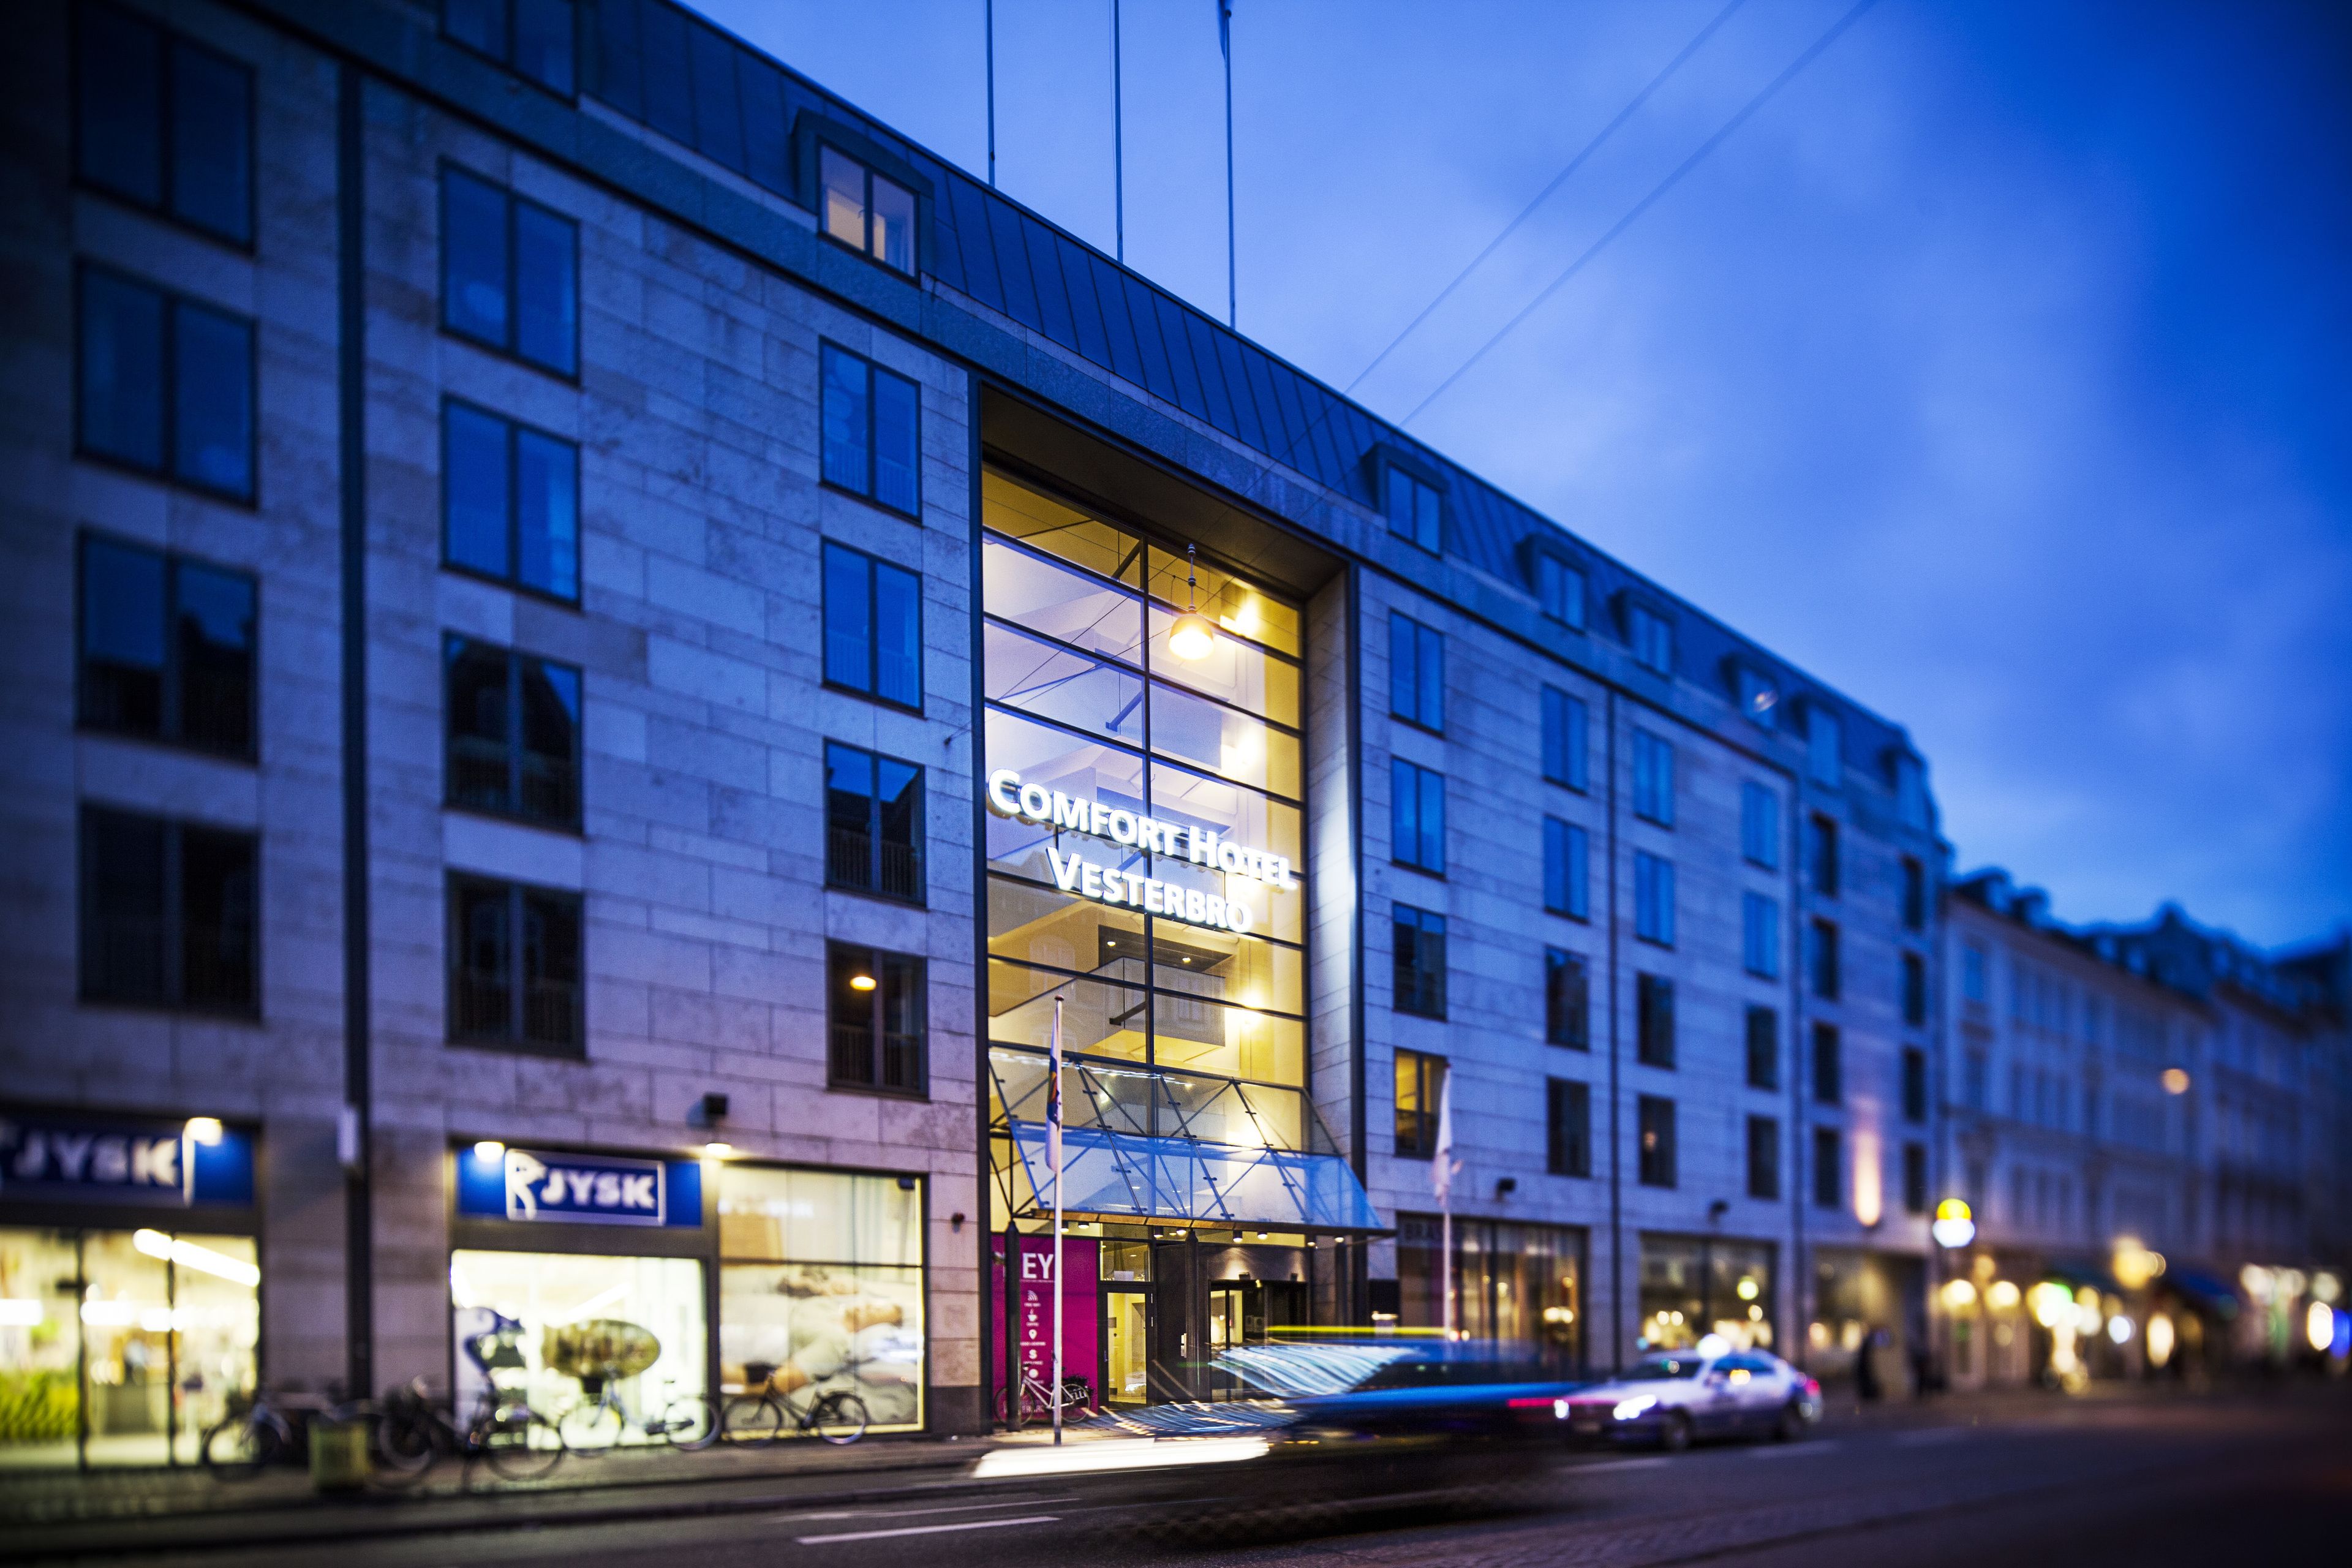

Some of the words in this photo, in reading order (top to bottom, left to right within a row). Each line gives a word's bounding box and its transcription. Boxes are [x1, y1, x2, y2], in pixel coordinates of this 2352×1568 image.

[988, 768, 1182, 856] COMFORT
[1188, 826, 1297, 890] HOTEL
[1047, 846, 1254, 933] VESTERBRO
[13, 1131, 178, 1186] JYSK
[540, 1169, 657, 1209] JYSK
[1003, 1253, 1054, 1279] EY
